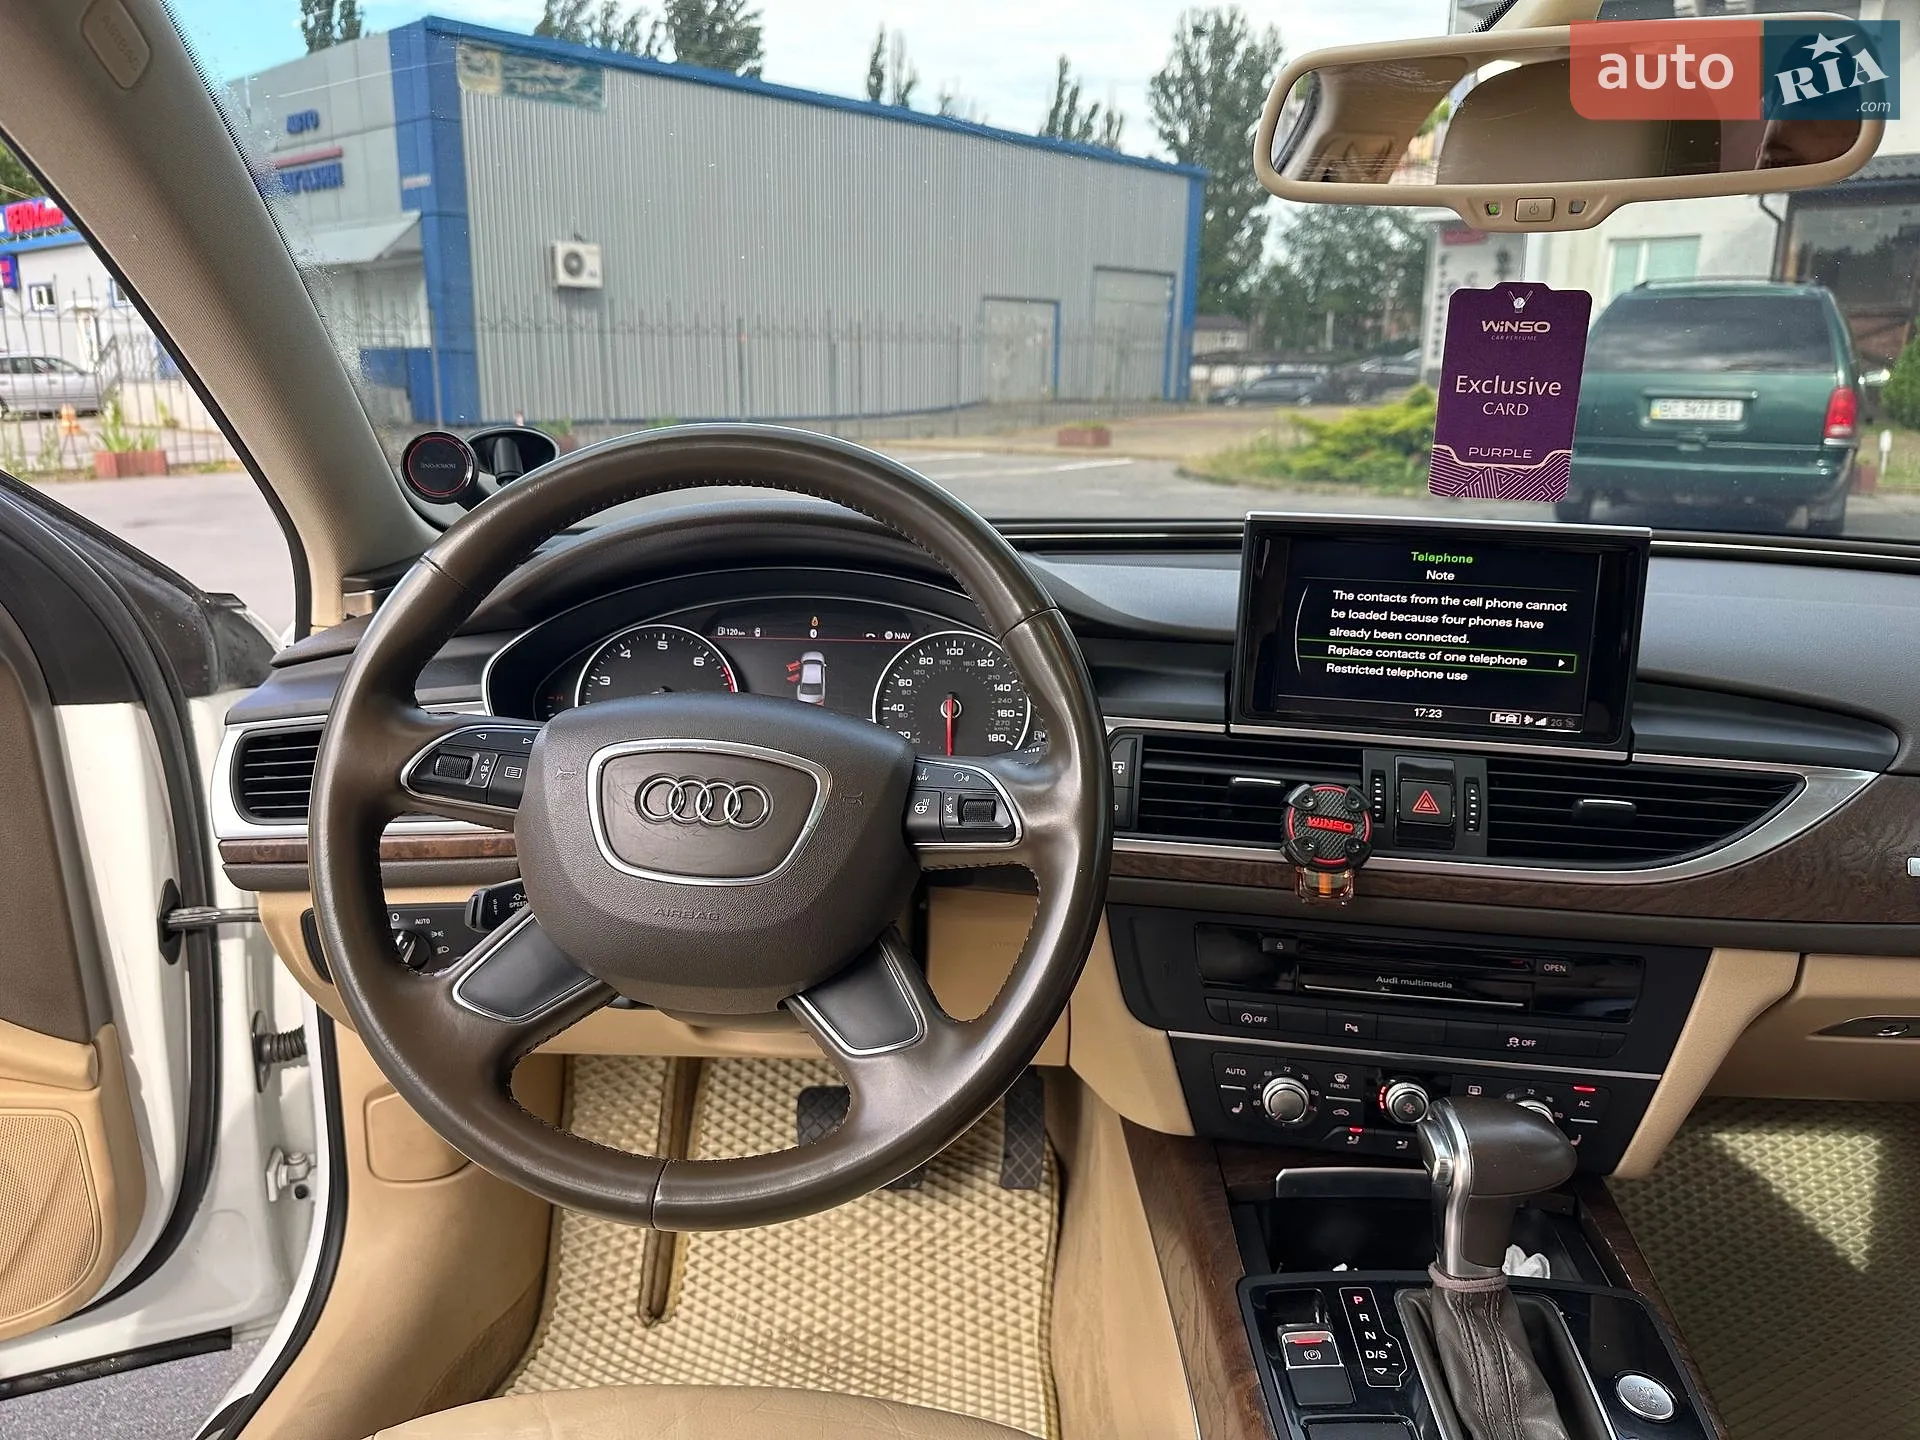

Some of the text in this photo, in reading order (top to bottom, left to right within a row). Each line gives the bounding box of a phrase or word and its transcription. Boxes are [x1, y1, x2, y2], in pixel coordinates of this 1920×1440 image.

[1455, 375, 1562, 396] Exclusive
[1482, 402, 1529, 416] CARD
[1468, 447, 1533, 458] PURPLE
[1411, 551, 1473, 565] Telephone
[1426, 570, 1455, 581] Note
[1333, 590, 1568, 611] The contacts from the cell phone cannot
[1331, 609, 1544, 629] be loaded because four phones have
[726, 628, 738, 636] 120
[1329, 627, 1470, 644] already been connected.
[657, 641, 668, 650] 5
[620, 649, 631, 659] 4
[946, 648, 963, 656] 100
[1328, 645, 1528, 665] Replace contacts of one telephone
[693, 657, 705, 666] 6
[919, 657, 933, 665] 80
[977, 659, 994, 667] 120
[1326, 663, 1468, 680] Restricted telephone use
[599, 676, 611, 686] 3
[898, 679, 912, 687] 60
[994, 684, 1011, 692] 140
[890, 704, 904, 712] 40
[997, 709, 1015, 718] 160
[1414, 708, 1442, 718] 17:23
[988, 734, 1006, 742] 180
[481, 765, 490, 773] OK
[654, 908, 720, 920] AIRBAG
[1544, 964, 1566, 972] OPEN
[1376, 976, 1452, 989] Audi multimedia
[1225, 1067, 1246, 1076] AUTO
[1579, 1100, 1590, 1108] AC
[1353, 1296, 1363, 1304] P
[1359, 1313, 1370, 1321] R
[1365, 1331, 1376, 1340] N
[1365, 1350, 1388, 1359] D/S
